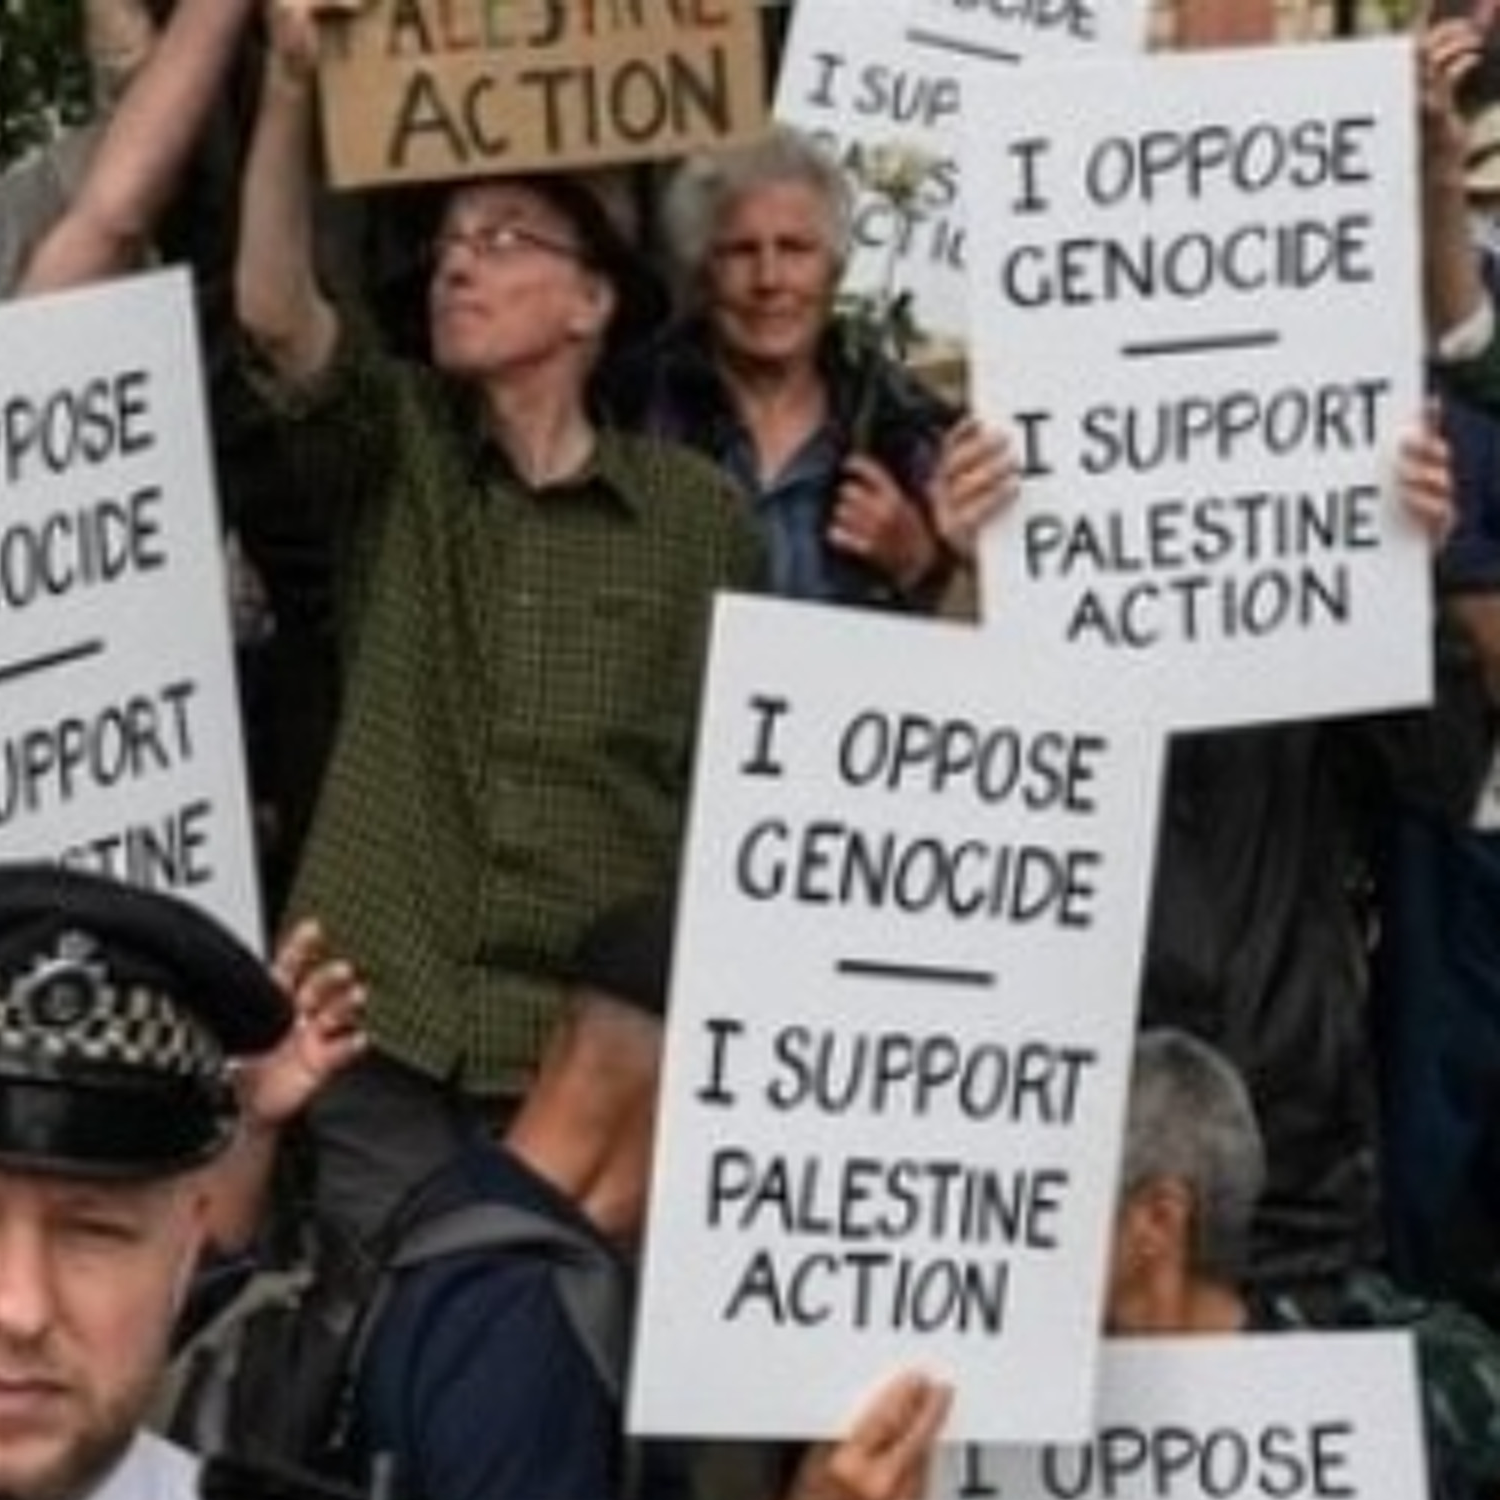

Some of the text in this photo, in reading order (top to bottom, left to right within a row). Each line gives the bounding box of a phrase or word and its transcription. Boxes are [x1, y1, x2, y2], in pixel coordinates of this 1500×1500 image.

[388, 46, 732, 168] ACTION
[806, 52, 844, 108] I
[1007, 136, 1050, 216] I
[1084, 114, 1378, 208] OPPOSE
[1000, 212, 1374, 310] GENOCIDE
[1012, 376, 1392, 481] I SUPPORT
[1022, 483, 1382, 581] PALESTINE
[1065, 564, 1352, 650] ACTION
[740, 693, 1108, 816] I OPPOSE
[735, 818, 1103, 931] GENOCIDE
[695, 1017, 1099, 1126] I SUPPORT
[705, 1146, 1071, 1251] PALESTINE
[722, 1248, 1010, 1337] ACTION
